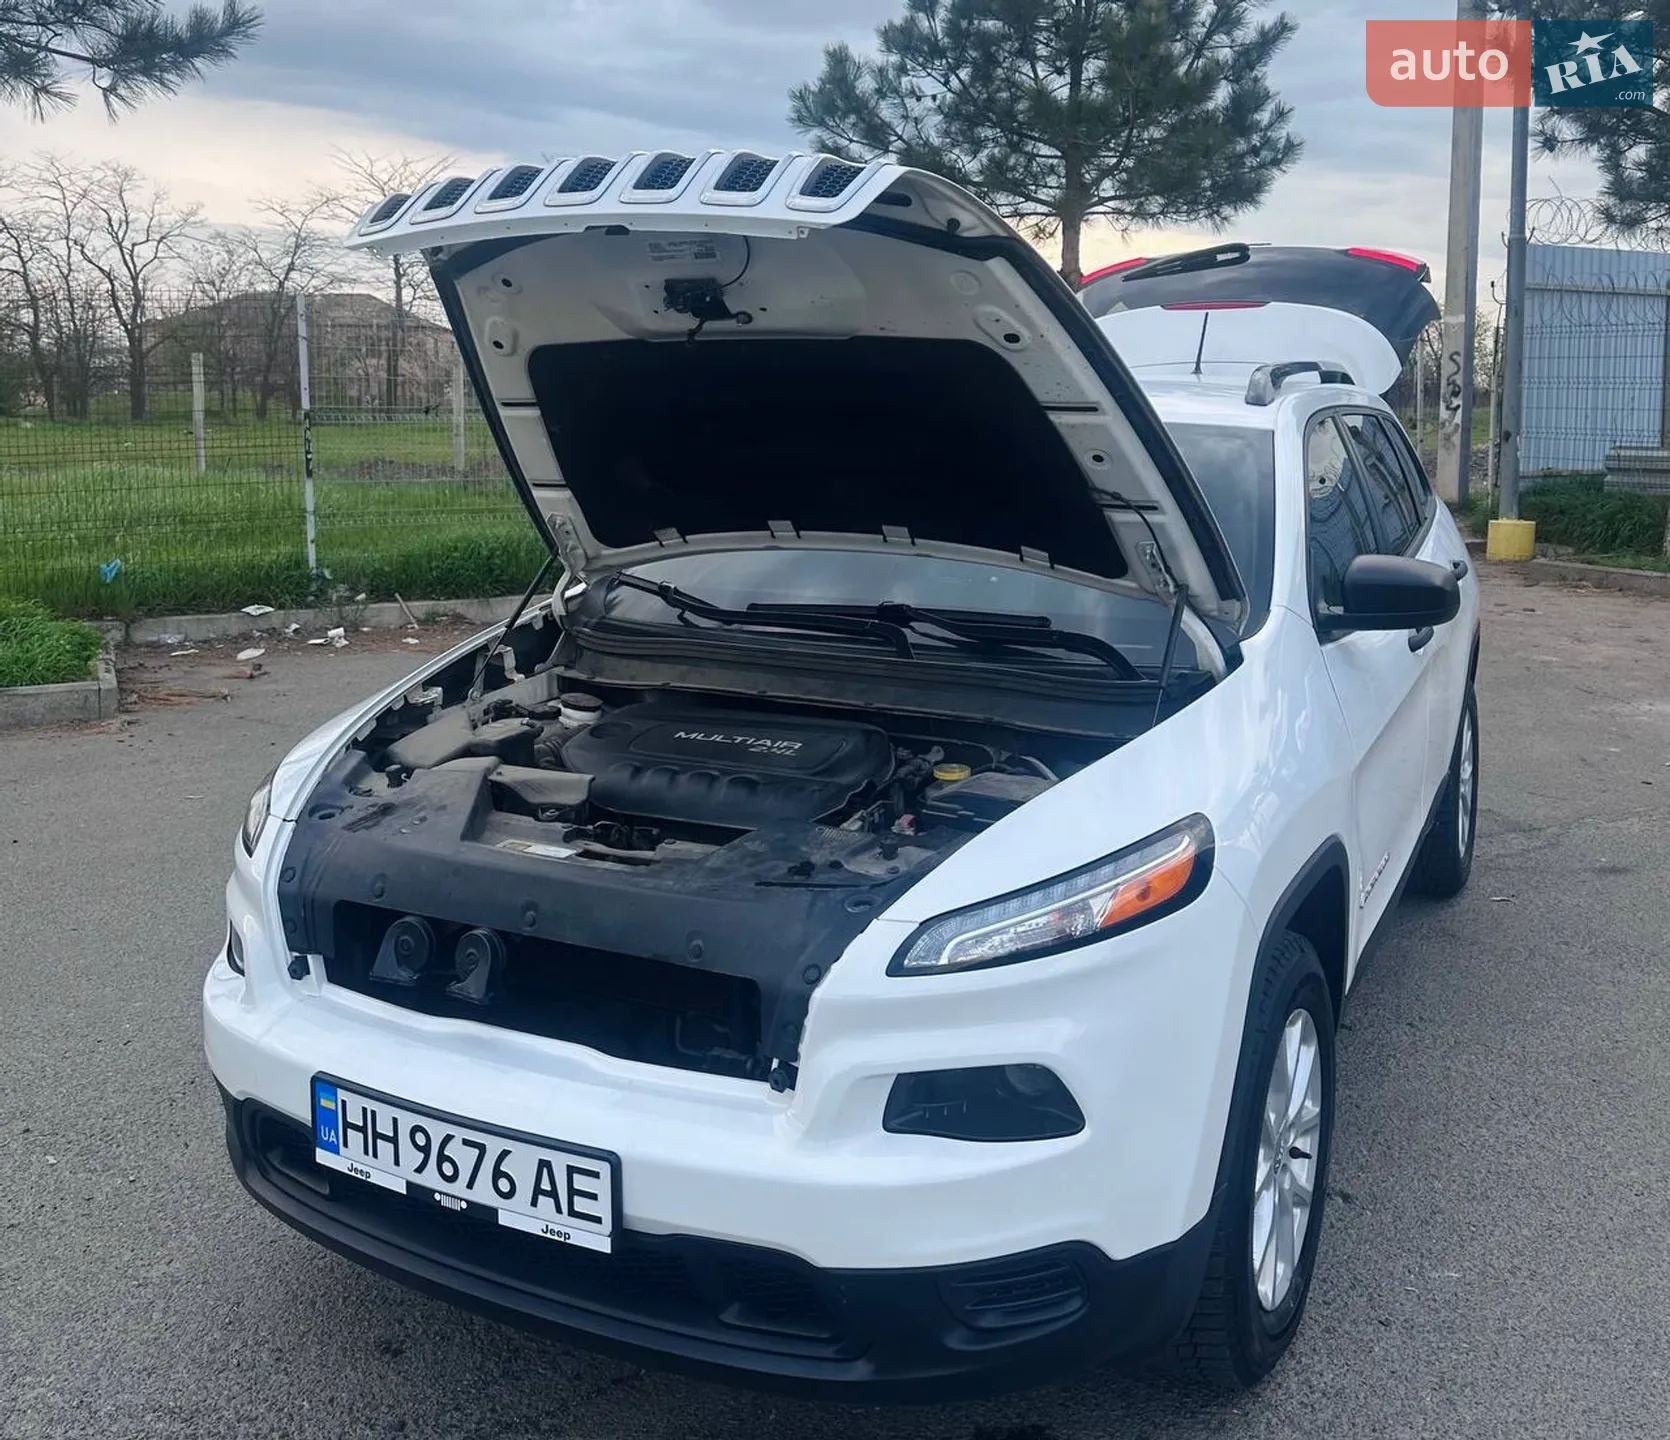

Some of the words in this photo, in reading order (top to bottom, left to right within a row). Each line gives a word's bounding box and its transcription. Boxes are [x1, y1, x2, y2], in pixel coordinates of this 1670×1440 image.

[674, 731, 802, 749] MULTIAIR
[321, 1127, 337, 1145] UA
[347, 1162, 372, 1180] Jeep
[409, 1124, 517, 1200] 9676
[541, 1223, 571, 1242] Jeep
